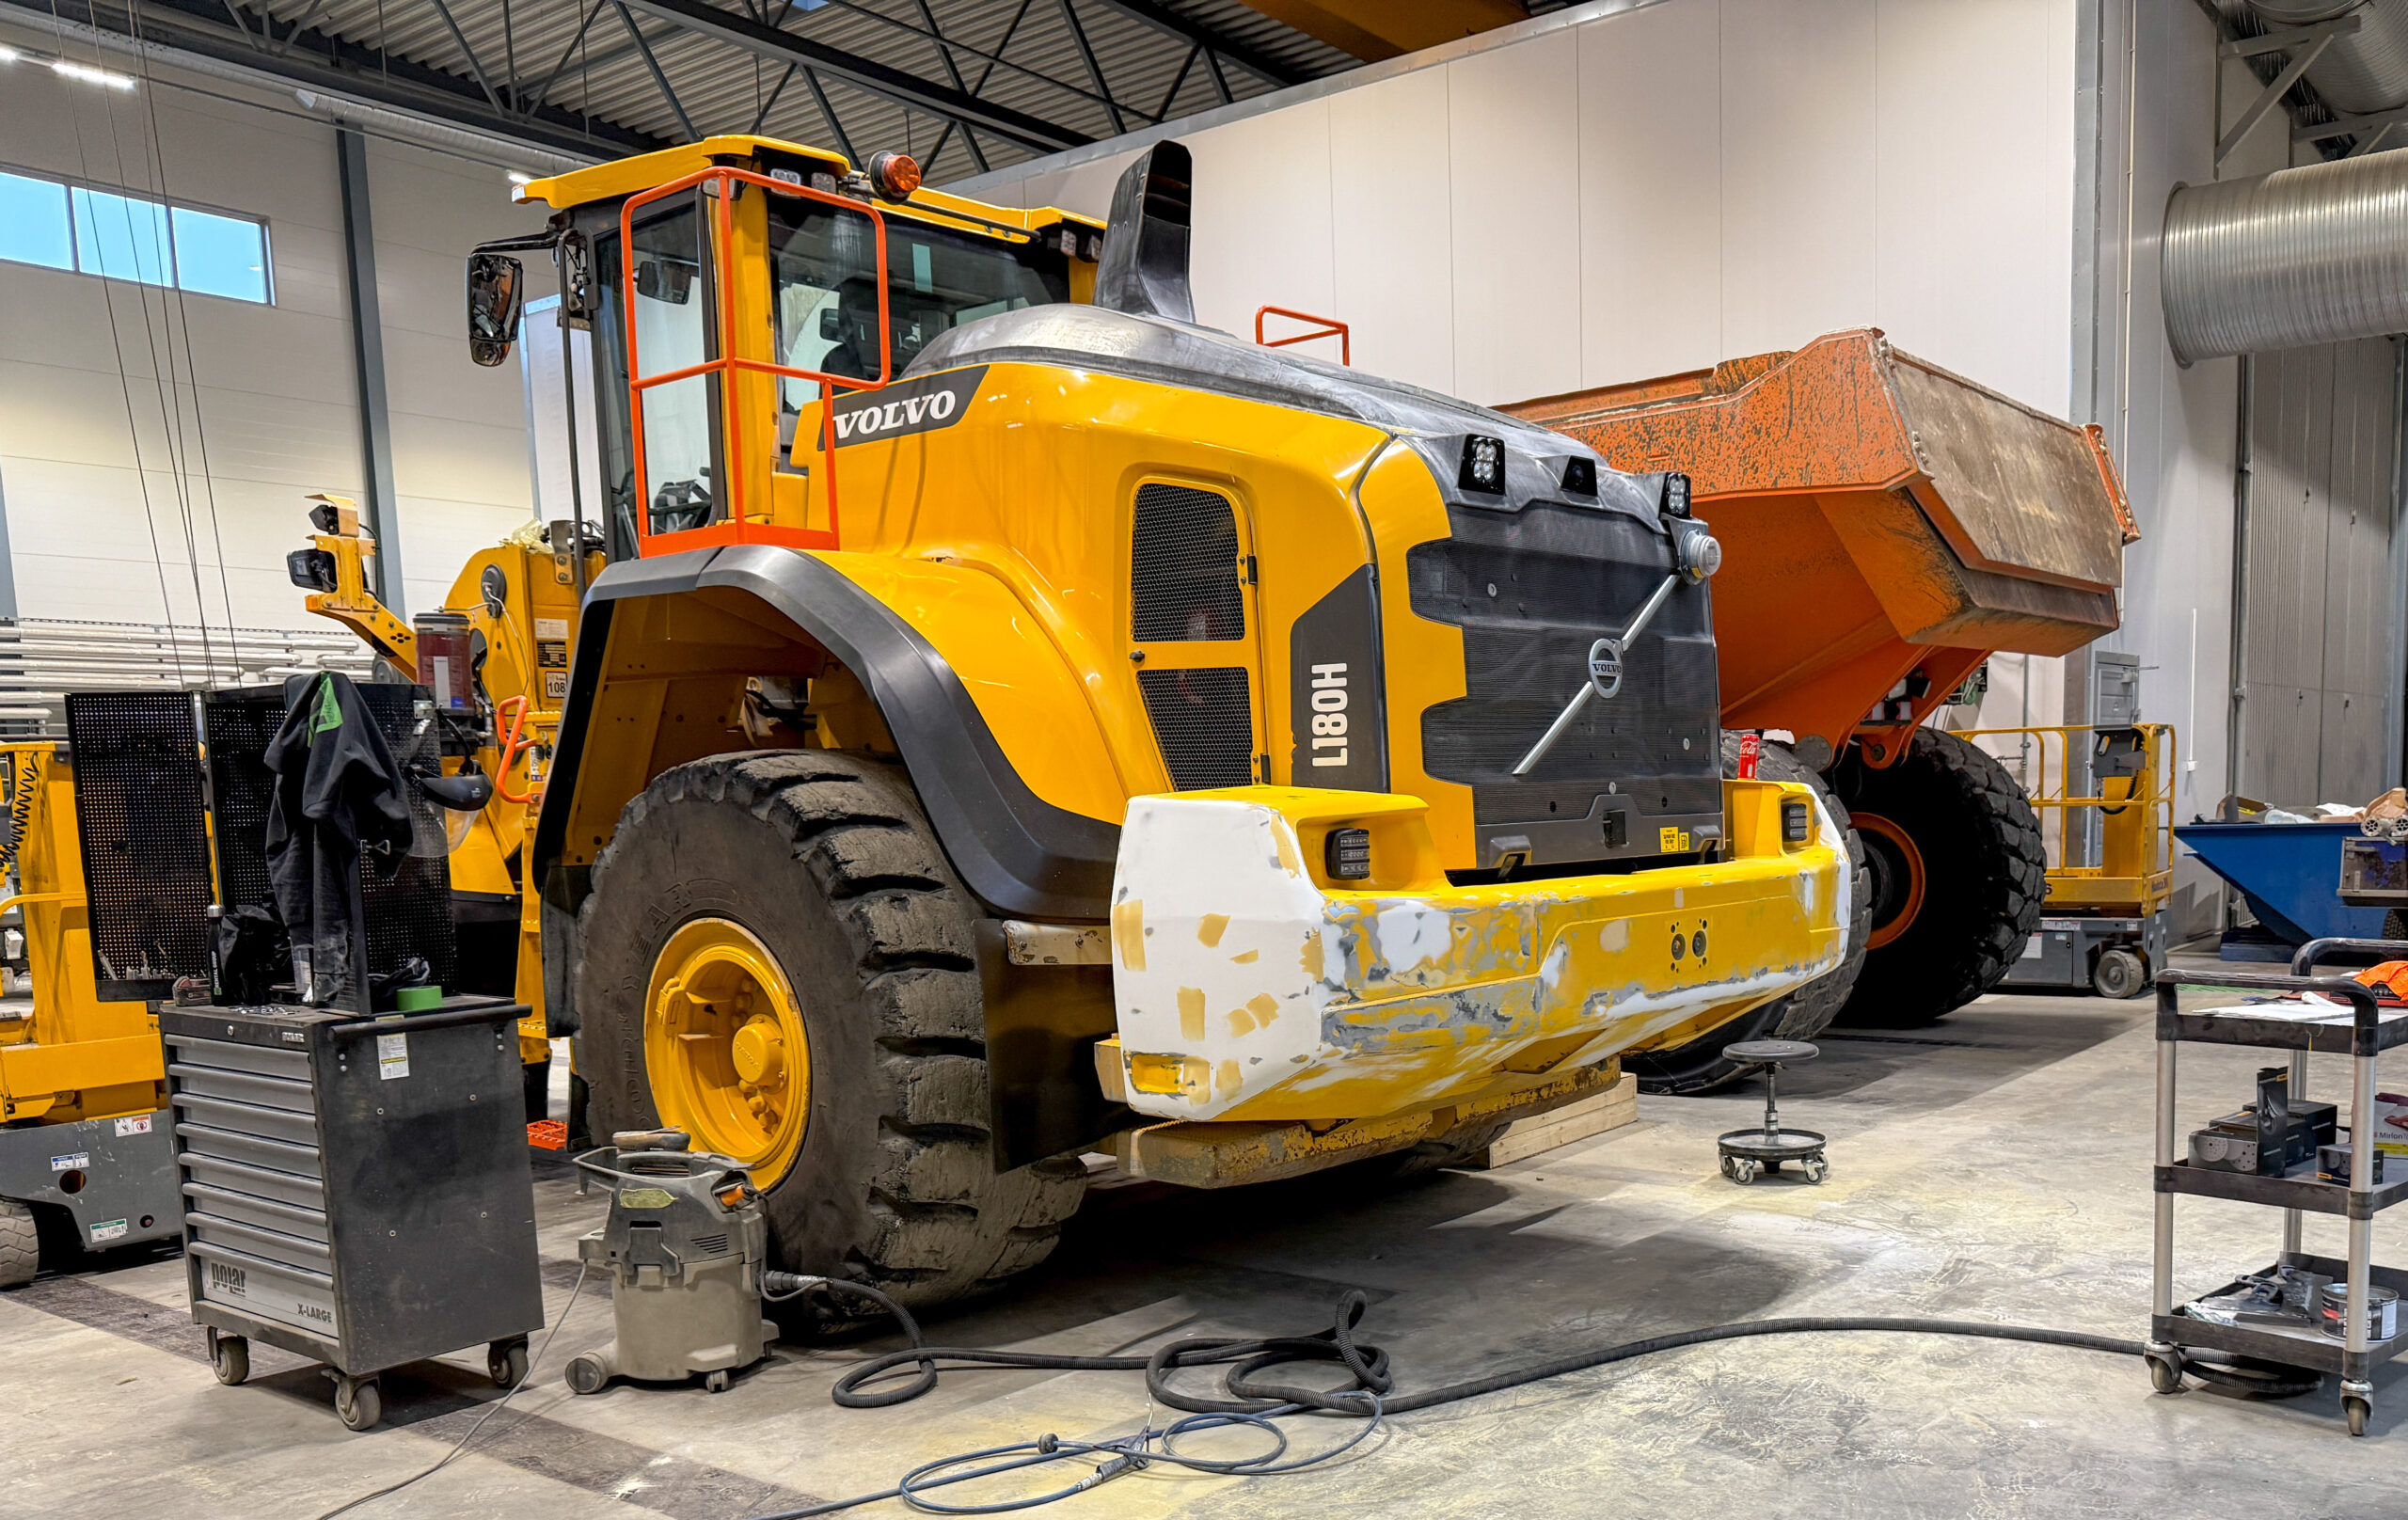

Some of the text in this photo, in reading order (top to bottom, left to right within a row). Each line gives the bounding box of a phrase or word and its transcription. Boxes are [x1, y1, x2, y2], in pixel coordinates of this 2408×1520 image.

[832, 389, 957, 439] VOLVO
[1592, 663, 1622, 673] VOLVO
[1311, 662, 1348, 767] L180H
[297, 1303, 332, 1323] X-LARGE
